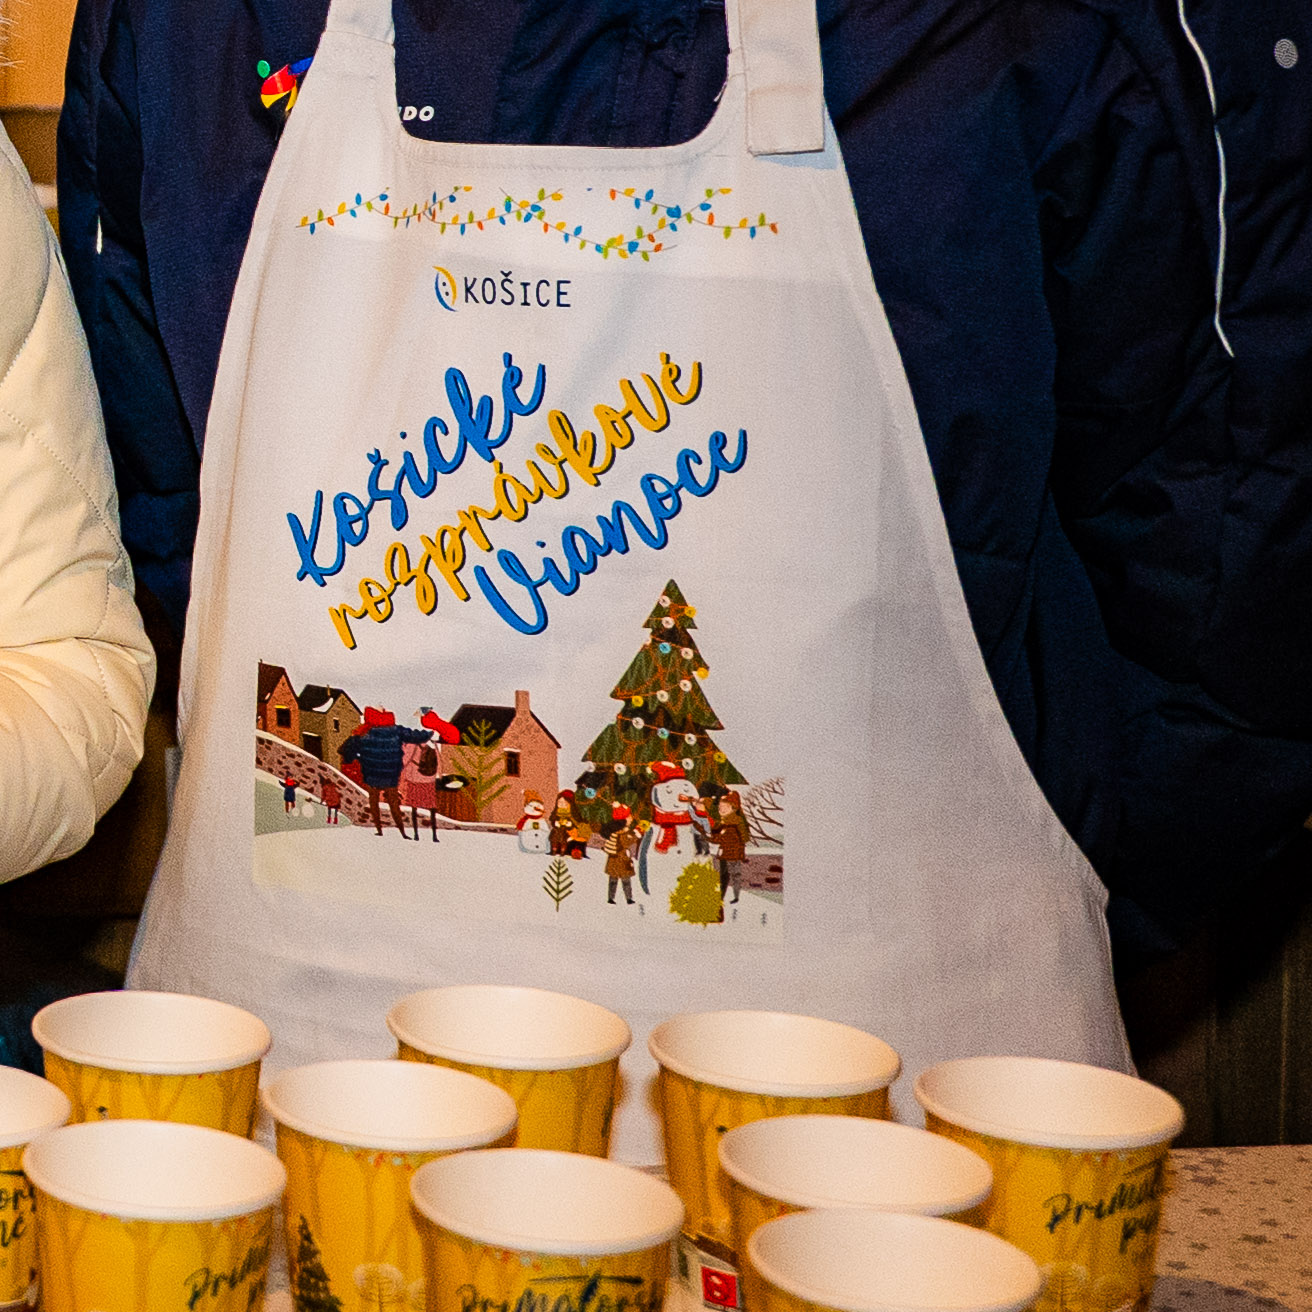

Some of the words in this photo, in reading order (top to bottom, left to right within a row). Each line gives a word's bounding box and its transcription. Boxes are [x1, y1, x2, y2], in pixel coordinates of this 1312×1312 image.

[463, 270, 573, 308] KOŠICE
[287, 352, 547, 587] Košické
[328, 352, 703, 650] rozprávkové
[473, 428, 749, 635] Vianoce
